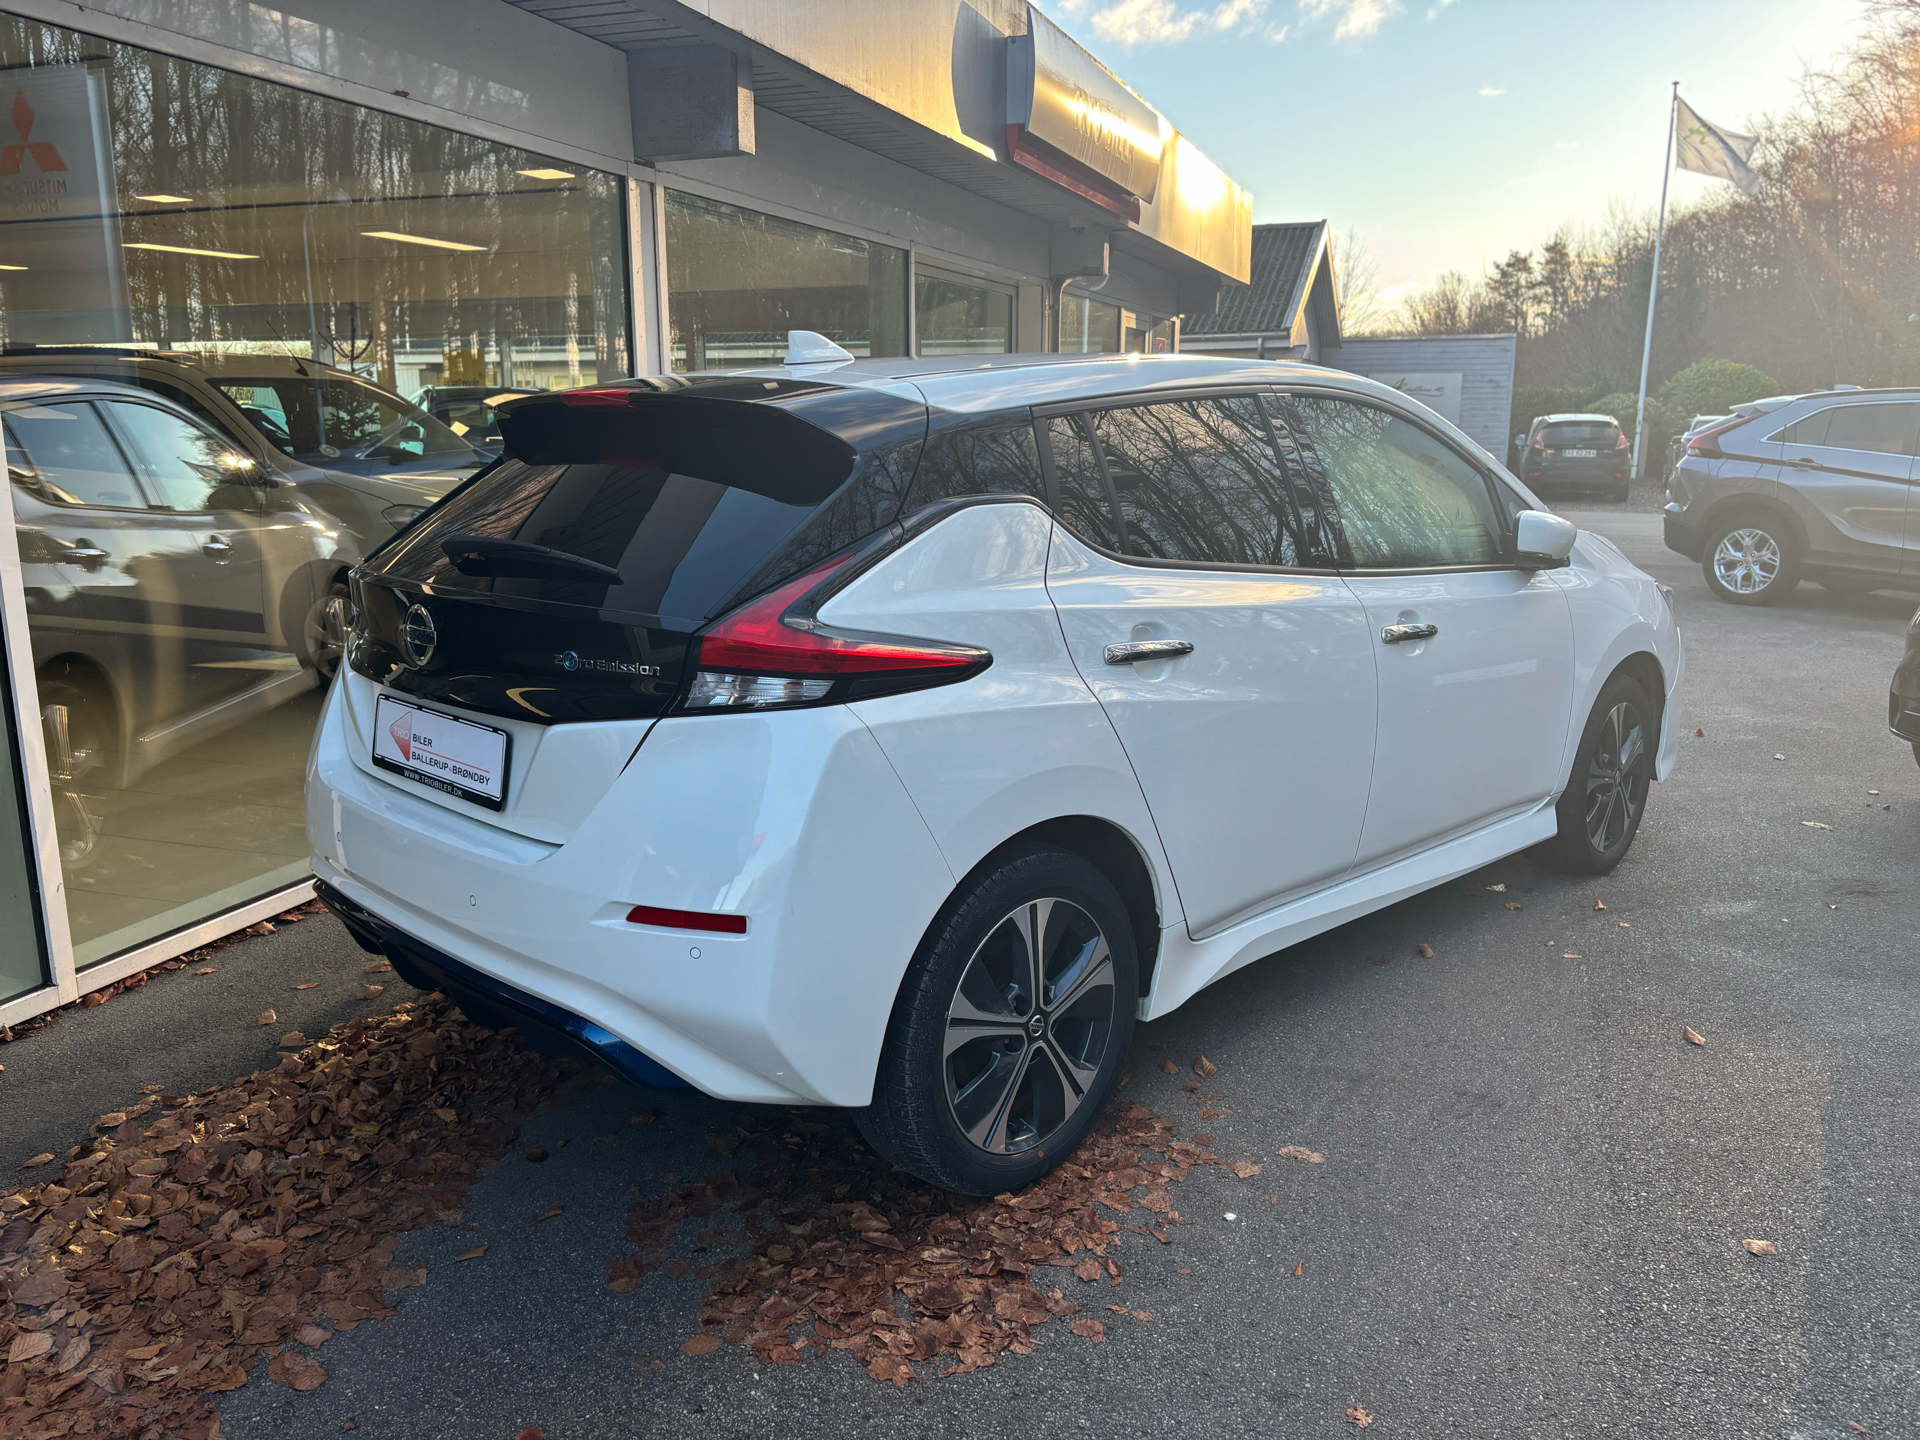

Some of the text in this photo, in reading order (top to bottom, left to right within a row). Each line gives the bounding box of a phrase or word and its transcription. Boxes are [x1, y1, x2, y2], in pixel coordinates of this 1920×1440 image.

[597, 660, 660, 676] Emission
[393, 726, 410, 740] TRIO
[412, 733, 433, 748] BILER
[403, 769, 463, 797] WWW.TRIOBILER.DK
